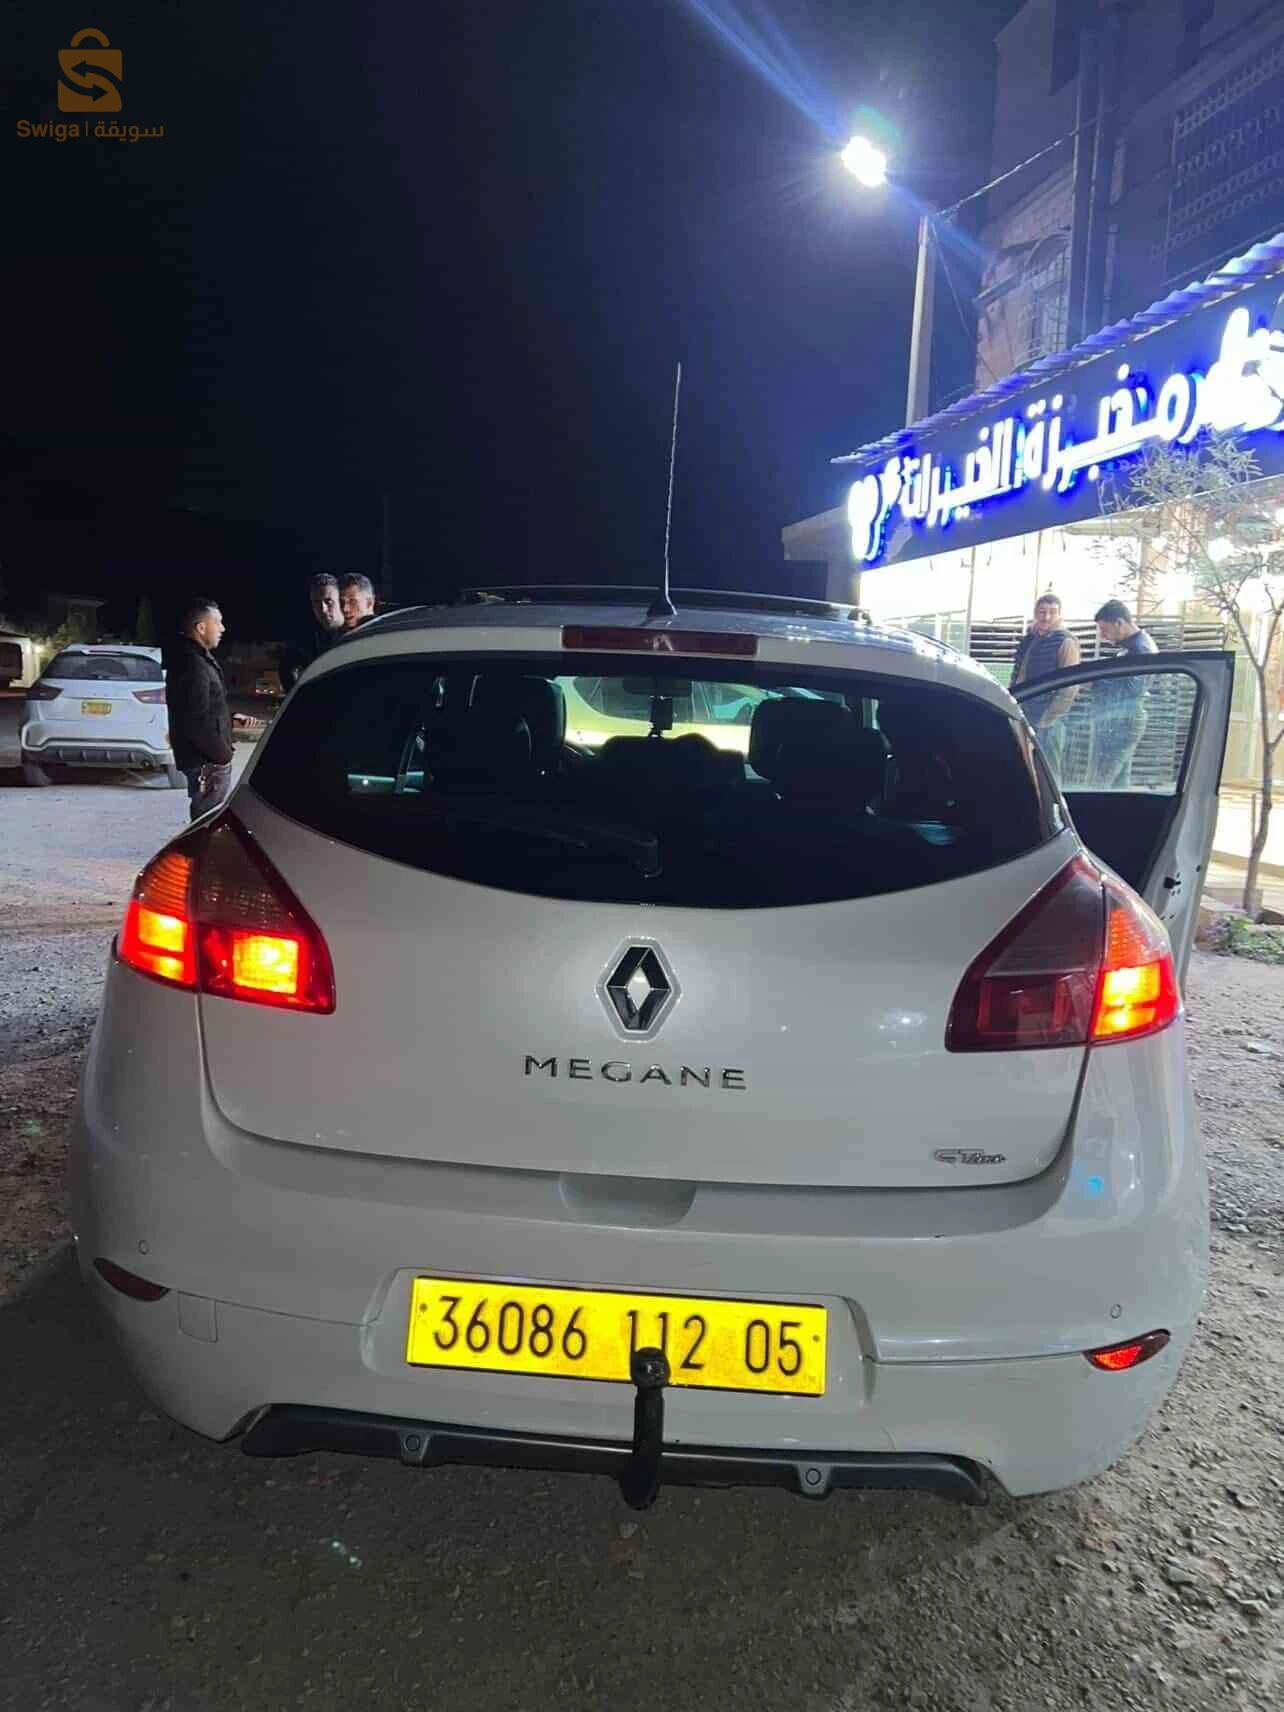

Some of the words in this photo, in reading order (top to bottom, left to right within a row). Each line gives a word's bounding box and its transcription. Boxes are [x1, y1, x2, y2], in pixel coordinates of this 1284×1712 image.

[900, 416, 1014, 528] الخيرات
[1023, 363, 1190, 493] مخبزة
[524, 1055, 747, 1090] MEGANE
[434, 1295, 587, 1360] 36086
[627, 1310, 707, 1369] 112
[744, 1319, 802, 1376] 05
